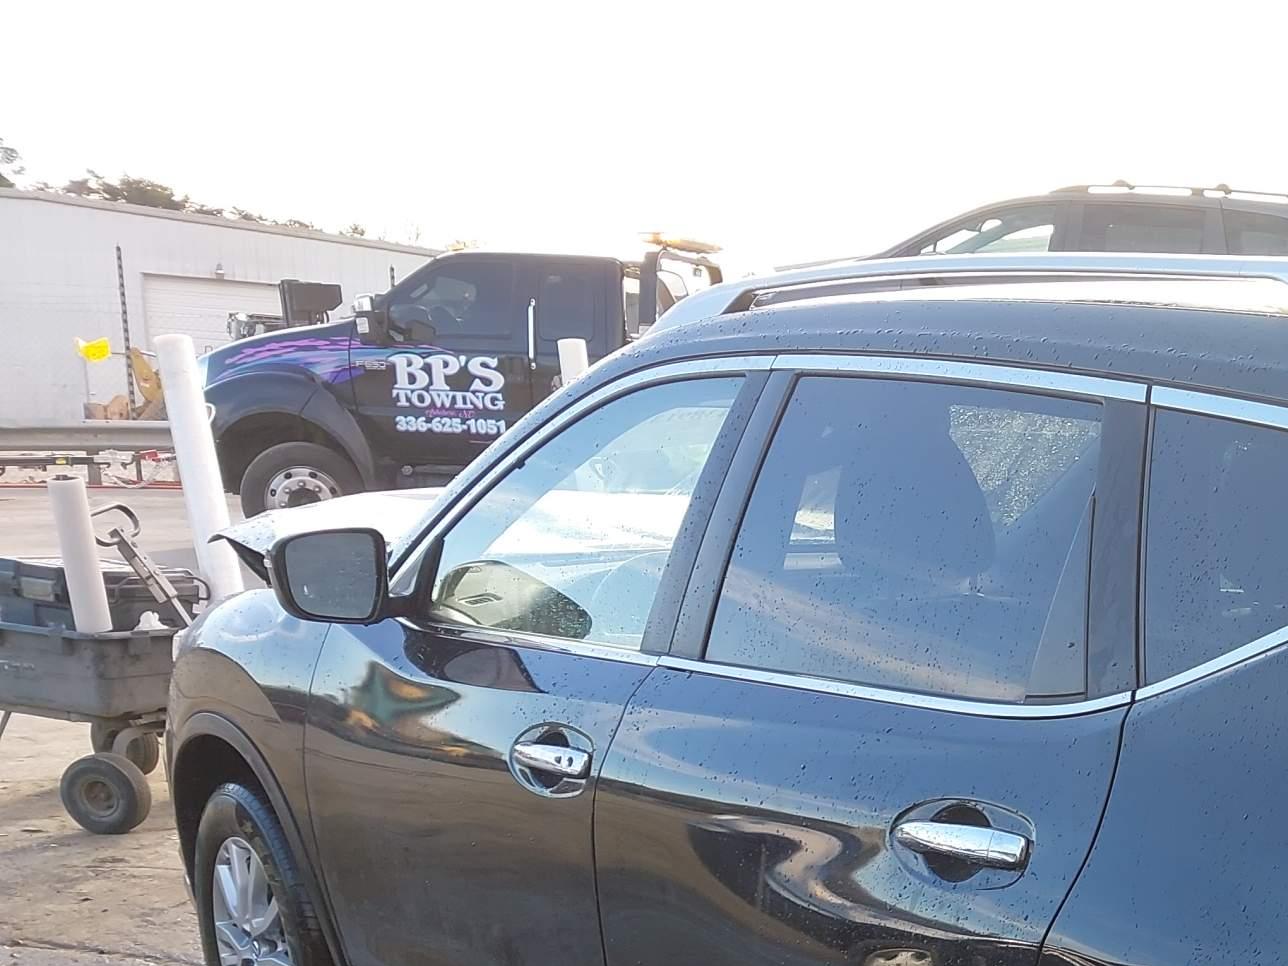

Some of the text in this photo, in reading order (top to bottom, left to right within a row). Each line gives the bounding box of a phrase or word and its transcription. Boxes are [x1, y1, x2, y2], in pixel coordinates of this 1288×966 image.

[387, 353, 505, 393] BP'S
[391, 388, 506, 411] TOWING
[395, 416, 506, 435] 336-625-1051
